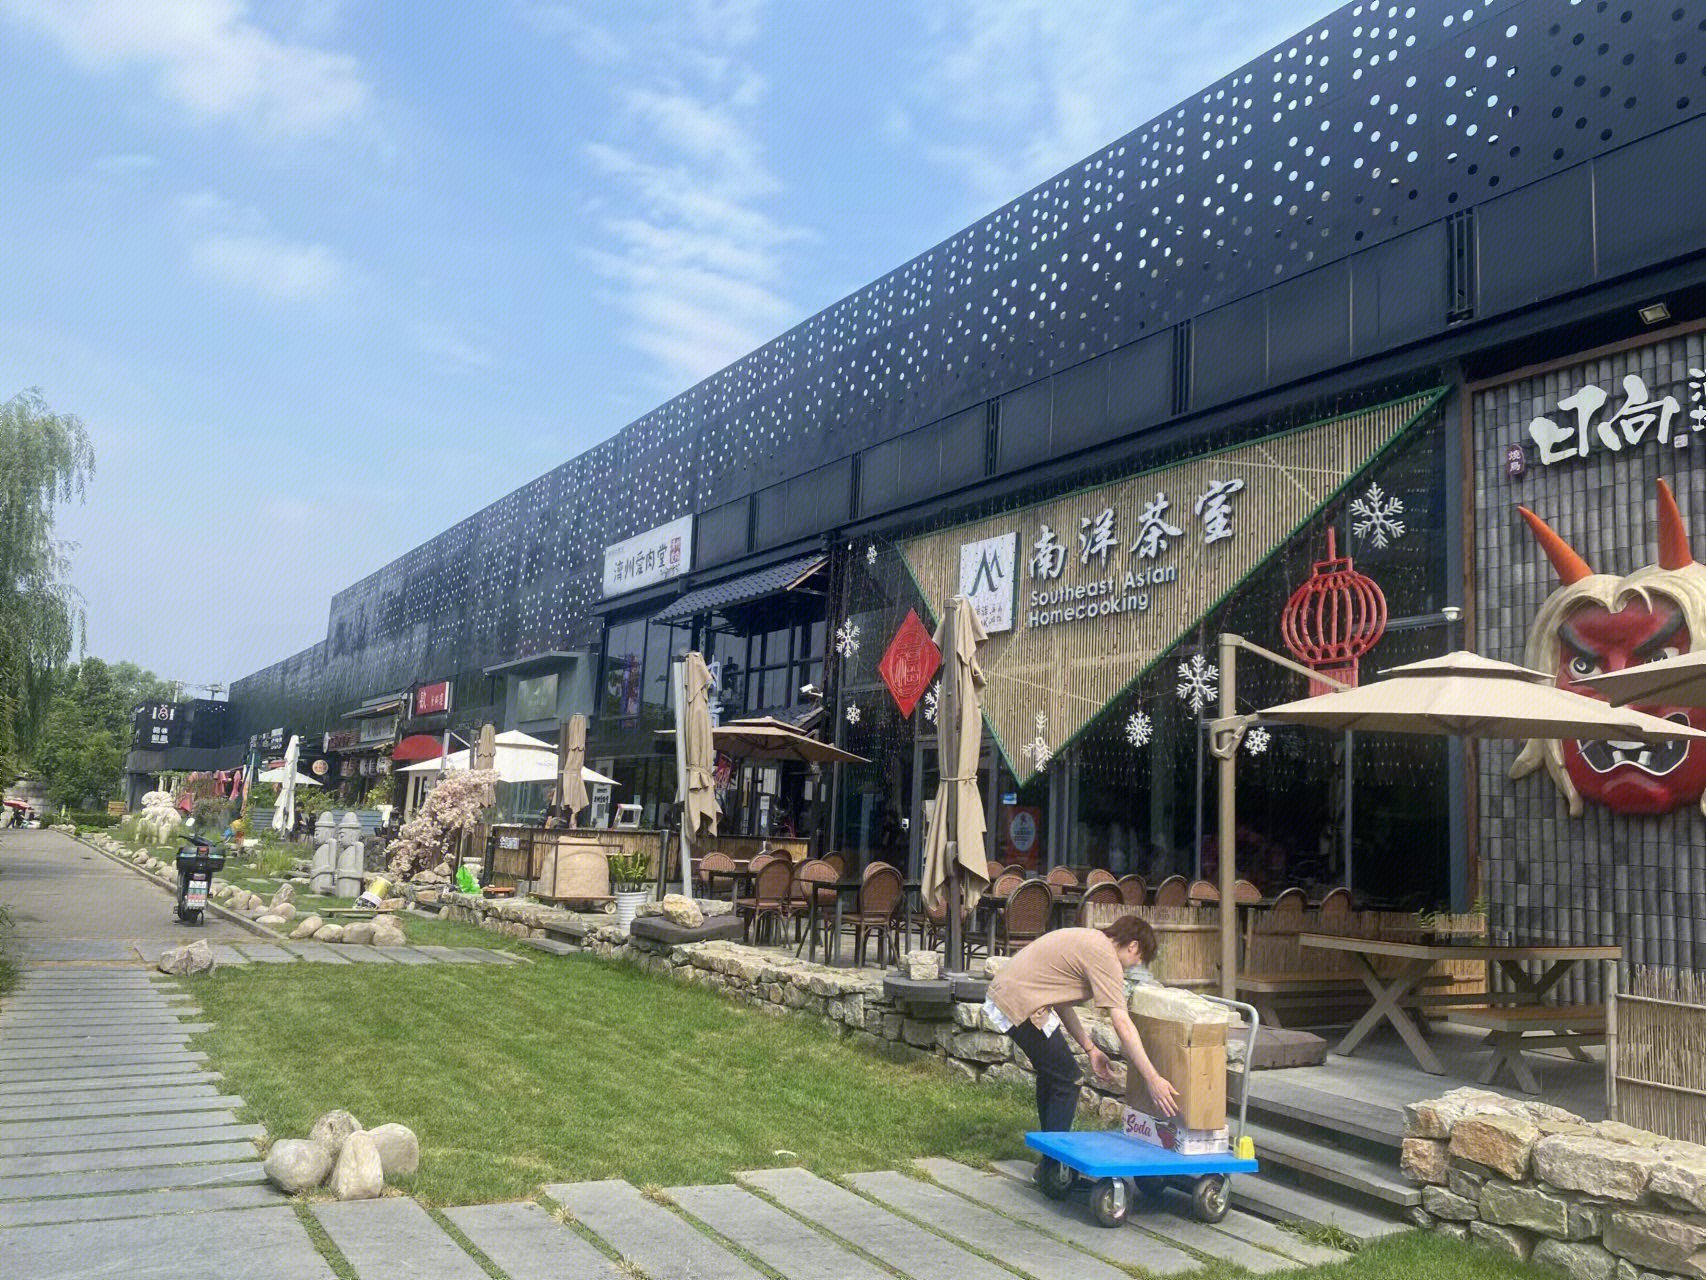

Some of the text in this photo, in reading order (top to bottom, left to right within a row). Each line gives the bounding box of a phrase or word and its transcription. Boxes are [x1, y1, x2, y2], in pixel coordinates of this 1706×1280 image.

[1028, 478, 1245, 580] 南洋茶室
[1030, 563, 1177, 607] Southeast Asian
[1028, 592, 1150, 628] Homecooking
[1125, 1113, 1152, 1137] Soda
